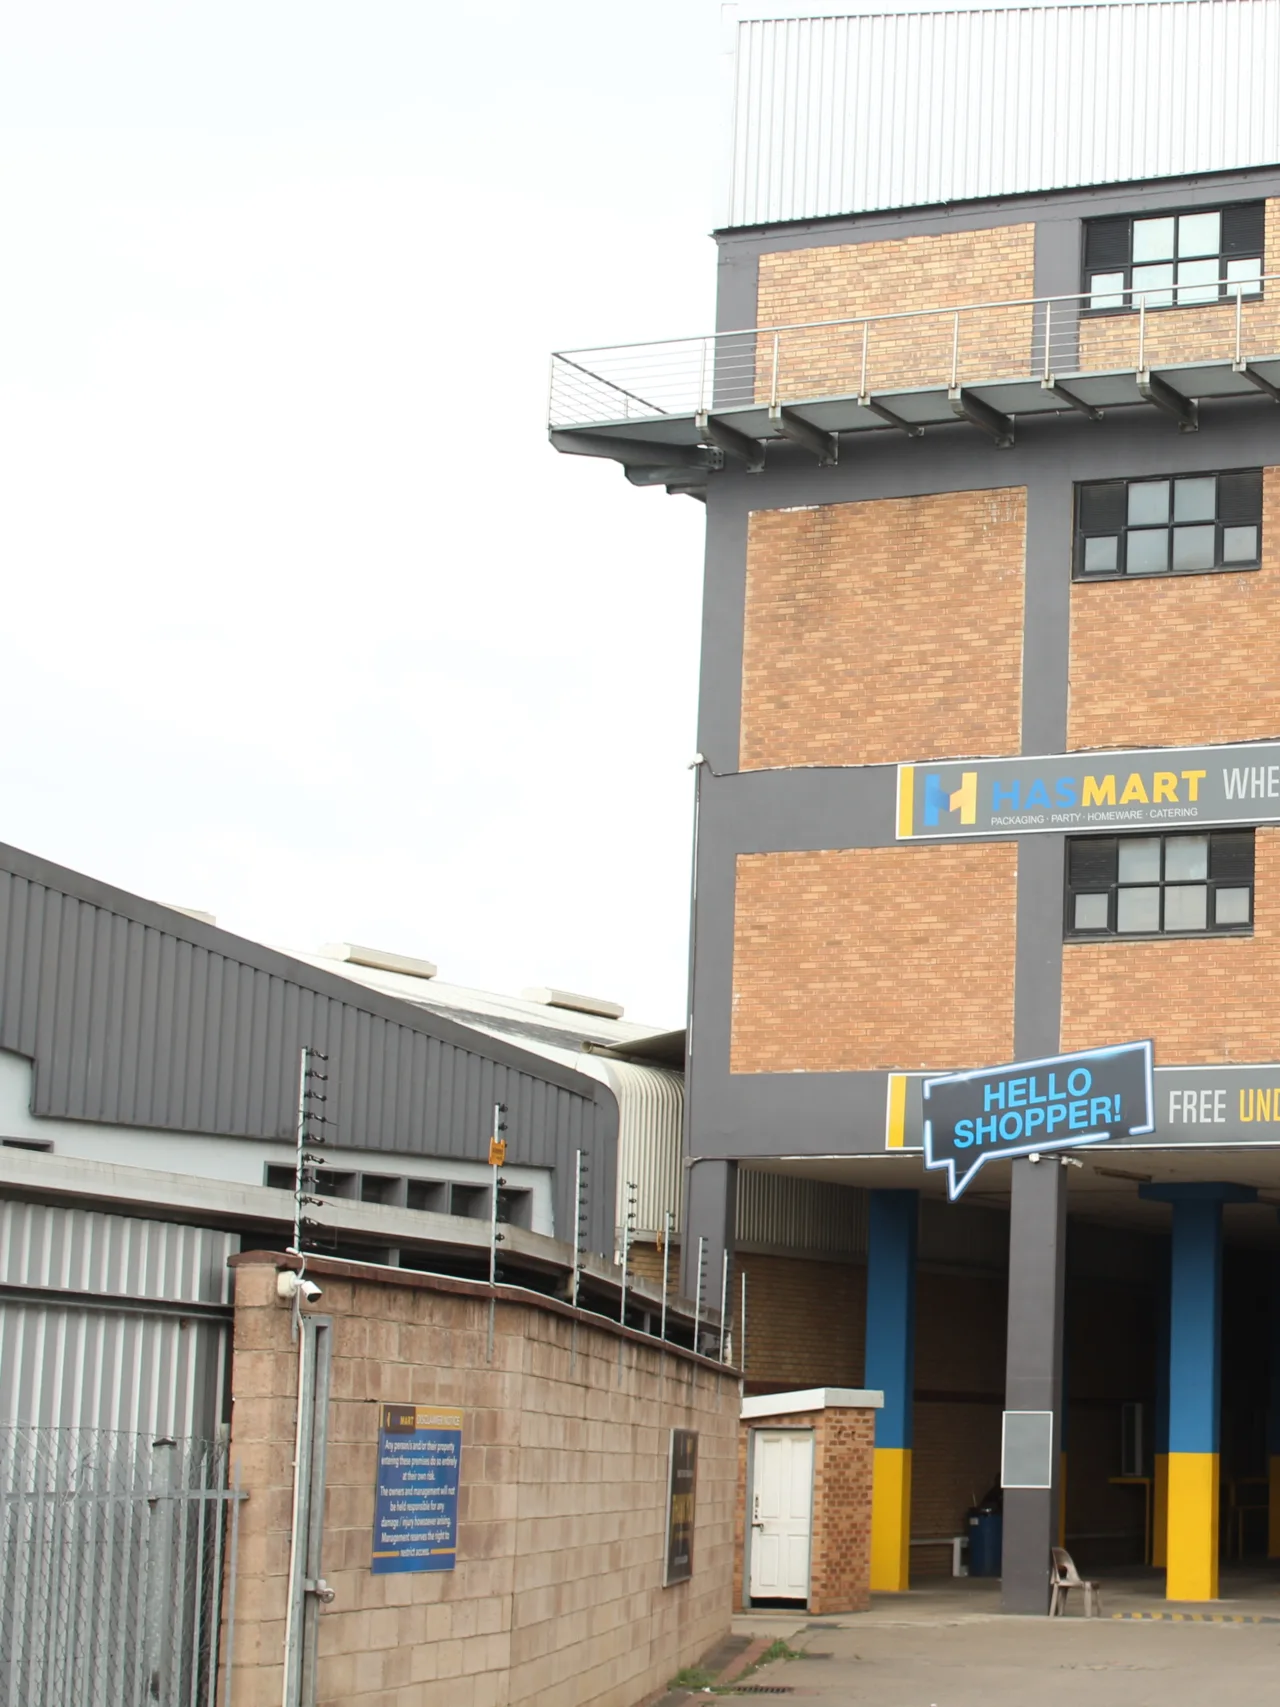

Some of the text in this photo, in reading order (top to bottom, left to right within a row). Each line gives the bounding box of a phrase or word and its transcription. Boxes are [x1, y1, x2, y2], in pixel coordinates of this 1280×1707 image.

[991, 769, 1207, 812] HASMART
[990, 806, 1198, 826] PACKAGING PARTY HOMEWARE CATERING
[983, 1067, 1092, 1112] HELLO
[1168, 1089, 1227, 1124] FREE
[953, 1094, 1122, 1149] SHOPPER!
